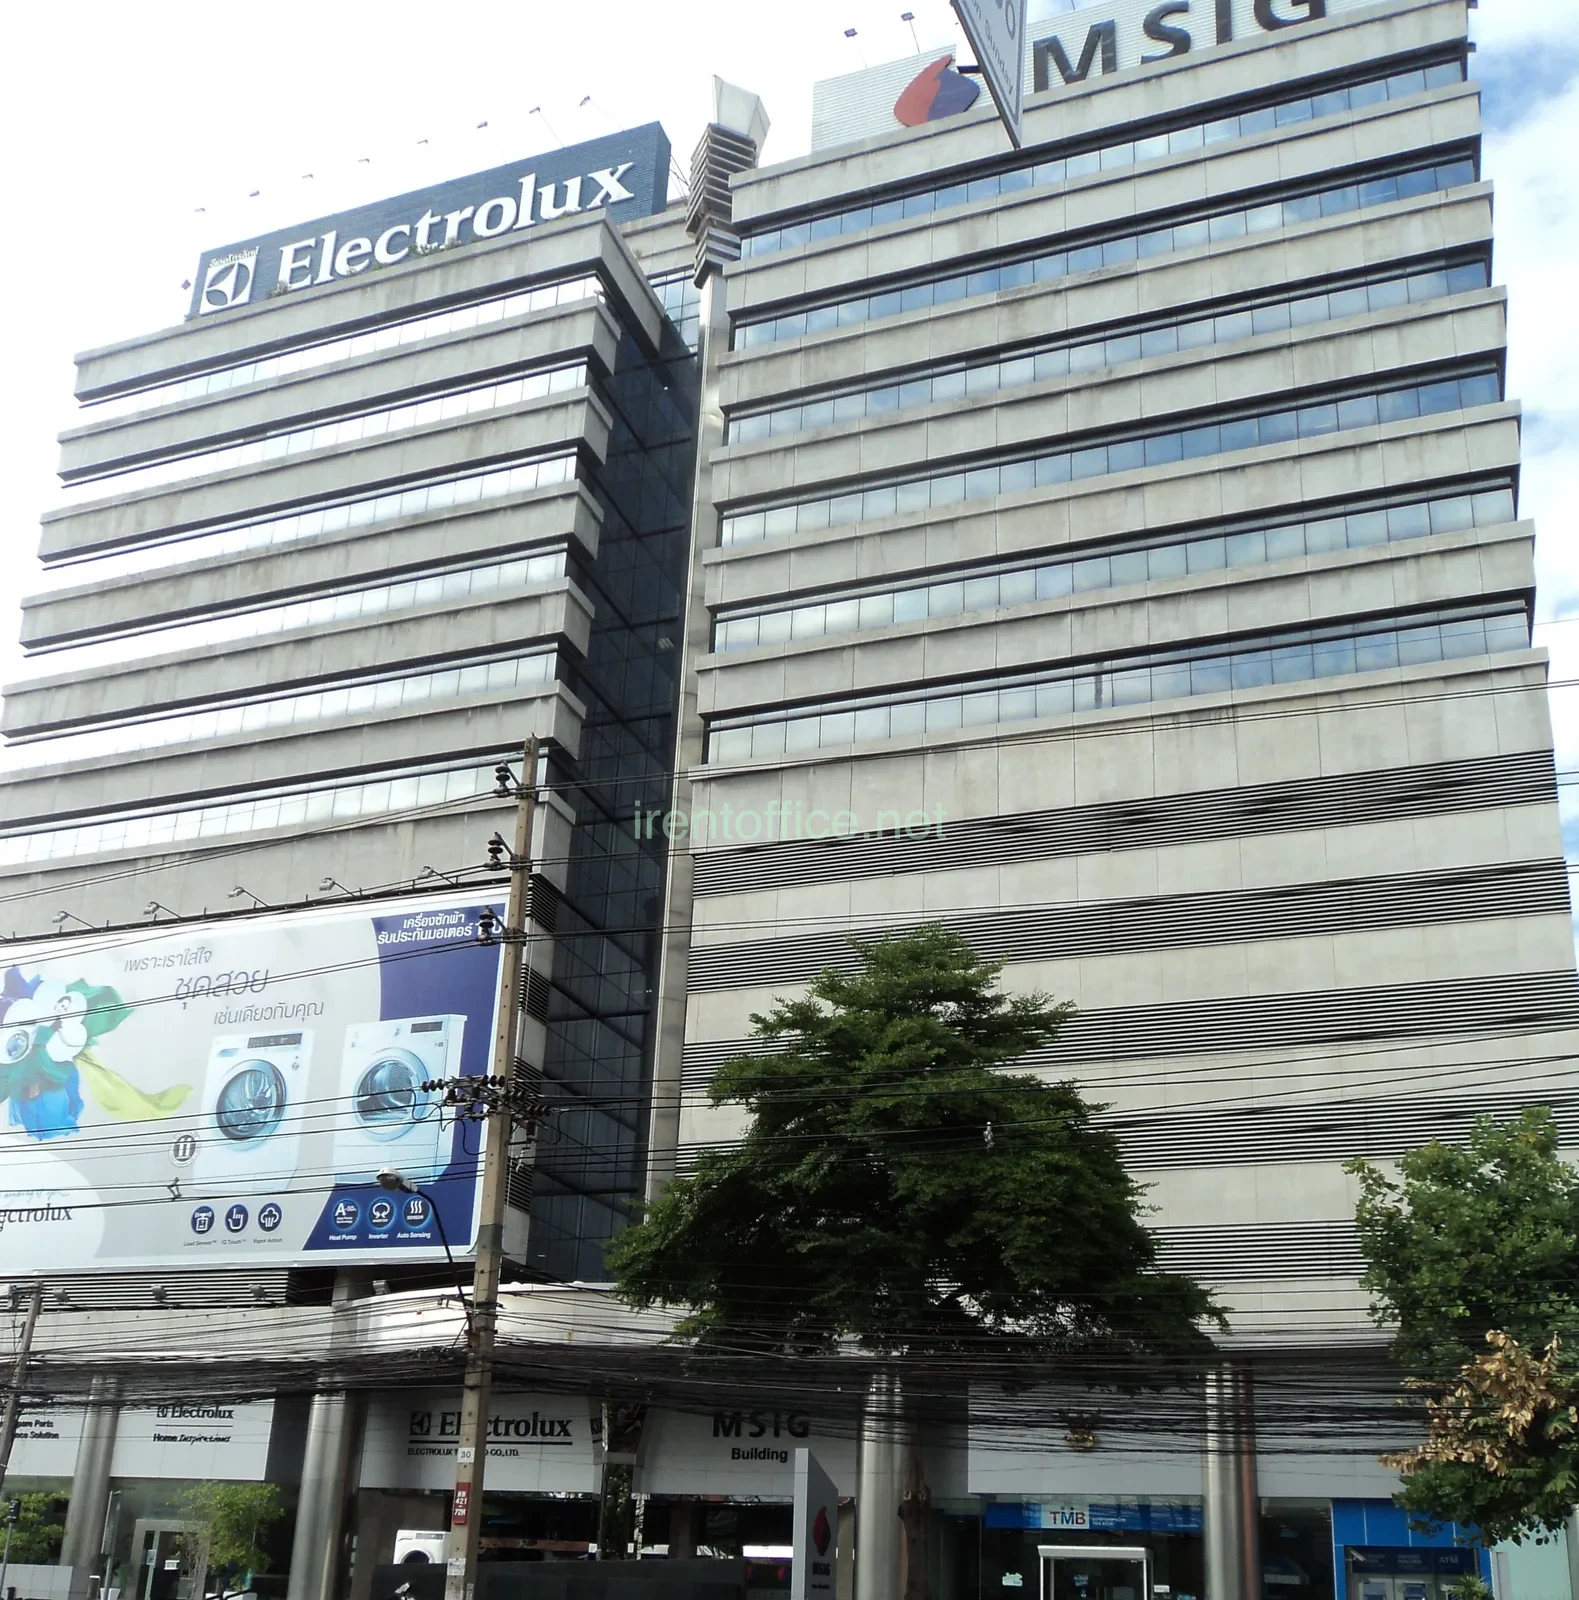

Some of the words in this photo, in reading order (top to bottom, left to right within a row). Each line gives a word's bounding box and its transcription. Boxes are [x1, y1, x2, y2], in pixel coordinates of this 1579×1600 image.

[1033, 0, 1326, 93] MSIG
[278, 162, 635, 290] Electrolux
[403, 911, 465, 928] เครื่องซักผ้า
[377, 922, 474, 944] รับประกันมอเตอร์
[124, 947, 213, 972] เพราะเราใส่ใจ
[214, 1001, 324, 1025] เช่นเดียวกับคุณ
[342, 1233, 357, 1241] Pump
[171, 1406, 234, 1419] Electrolux
[34, 1419, 54, 1428] Parts
[439, 1411, 573, 1437] Elctrolux
[712, 1410, 809, 1438] MSIG
[29, 1431, 60, 1439] Solution
[153, 1433, 177, 1442] Home
[178, 1433, 232, 1446] Inspirations
[407, 1448, 453, 1456] ELECTROLUX
[460, 1451, 471, 1459] 30
[731, 1447, 788, 1463] Building
[1050, 1511, 1085, 1525] TMB
